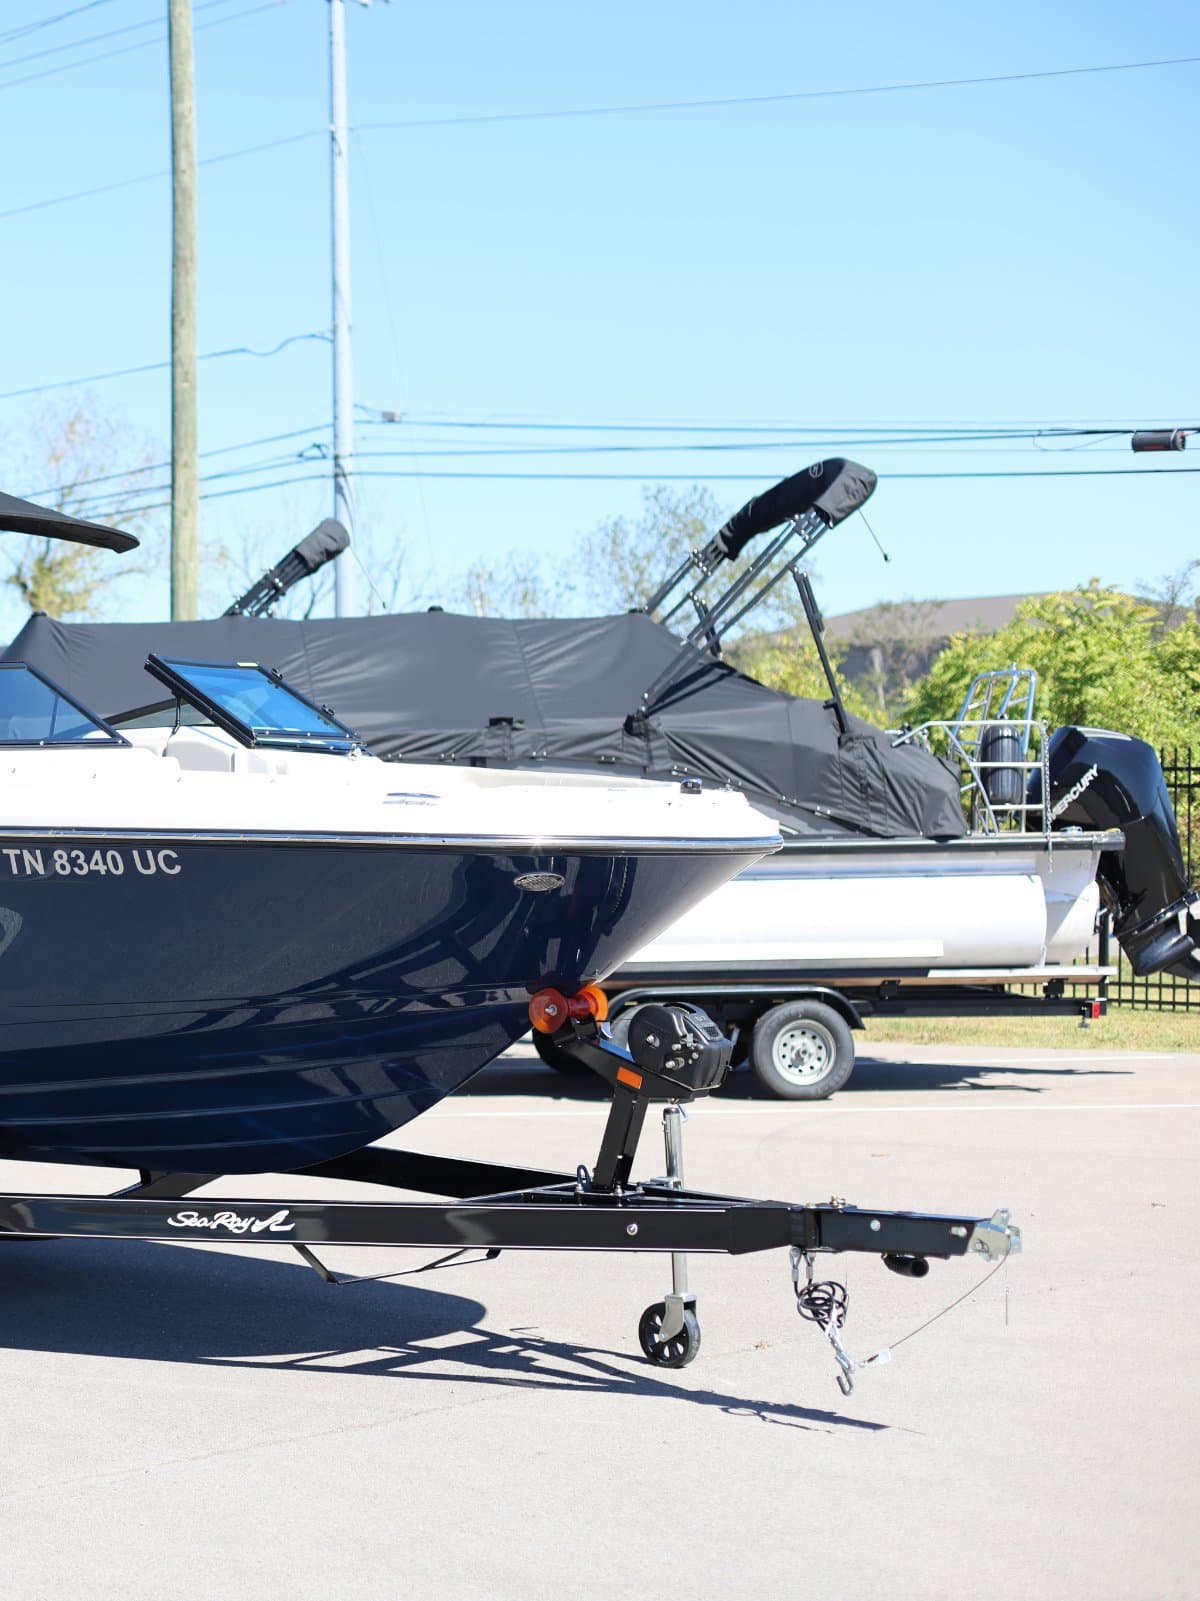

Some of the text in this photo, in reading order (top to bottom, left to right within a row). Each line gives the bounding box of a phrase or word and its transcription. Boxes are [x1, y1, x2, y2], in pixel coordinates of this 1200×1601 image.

[2, 849, 182, 876] TN 8340 UC
